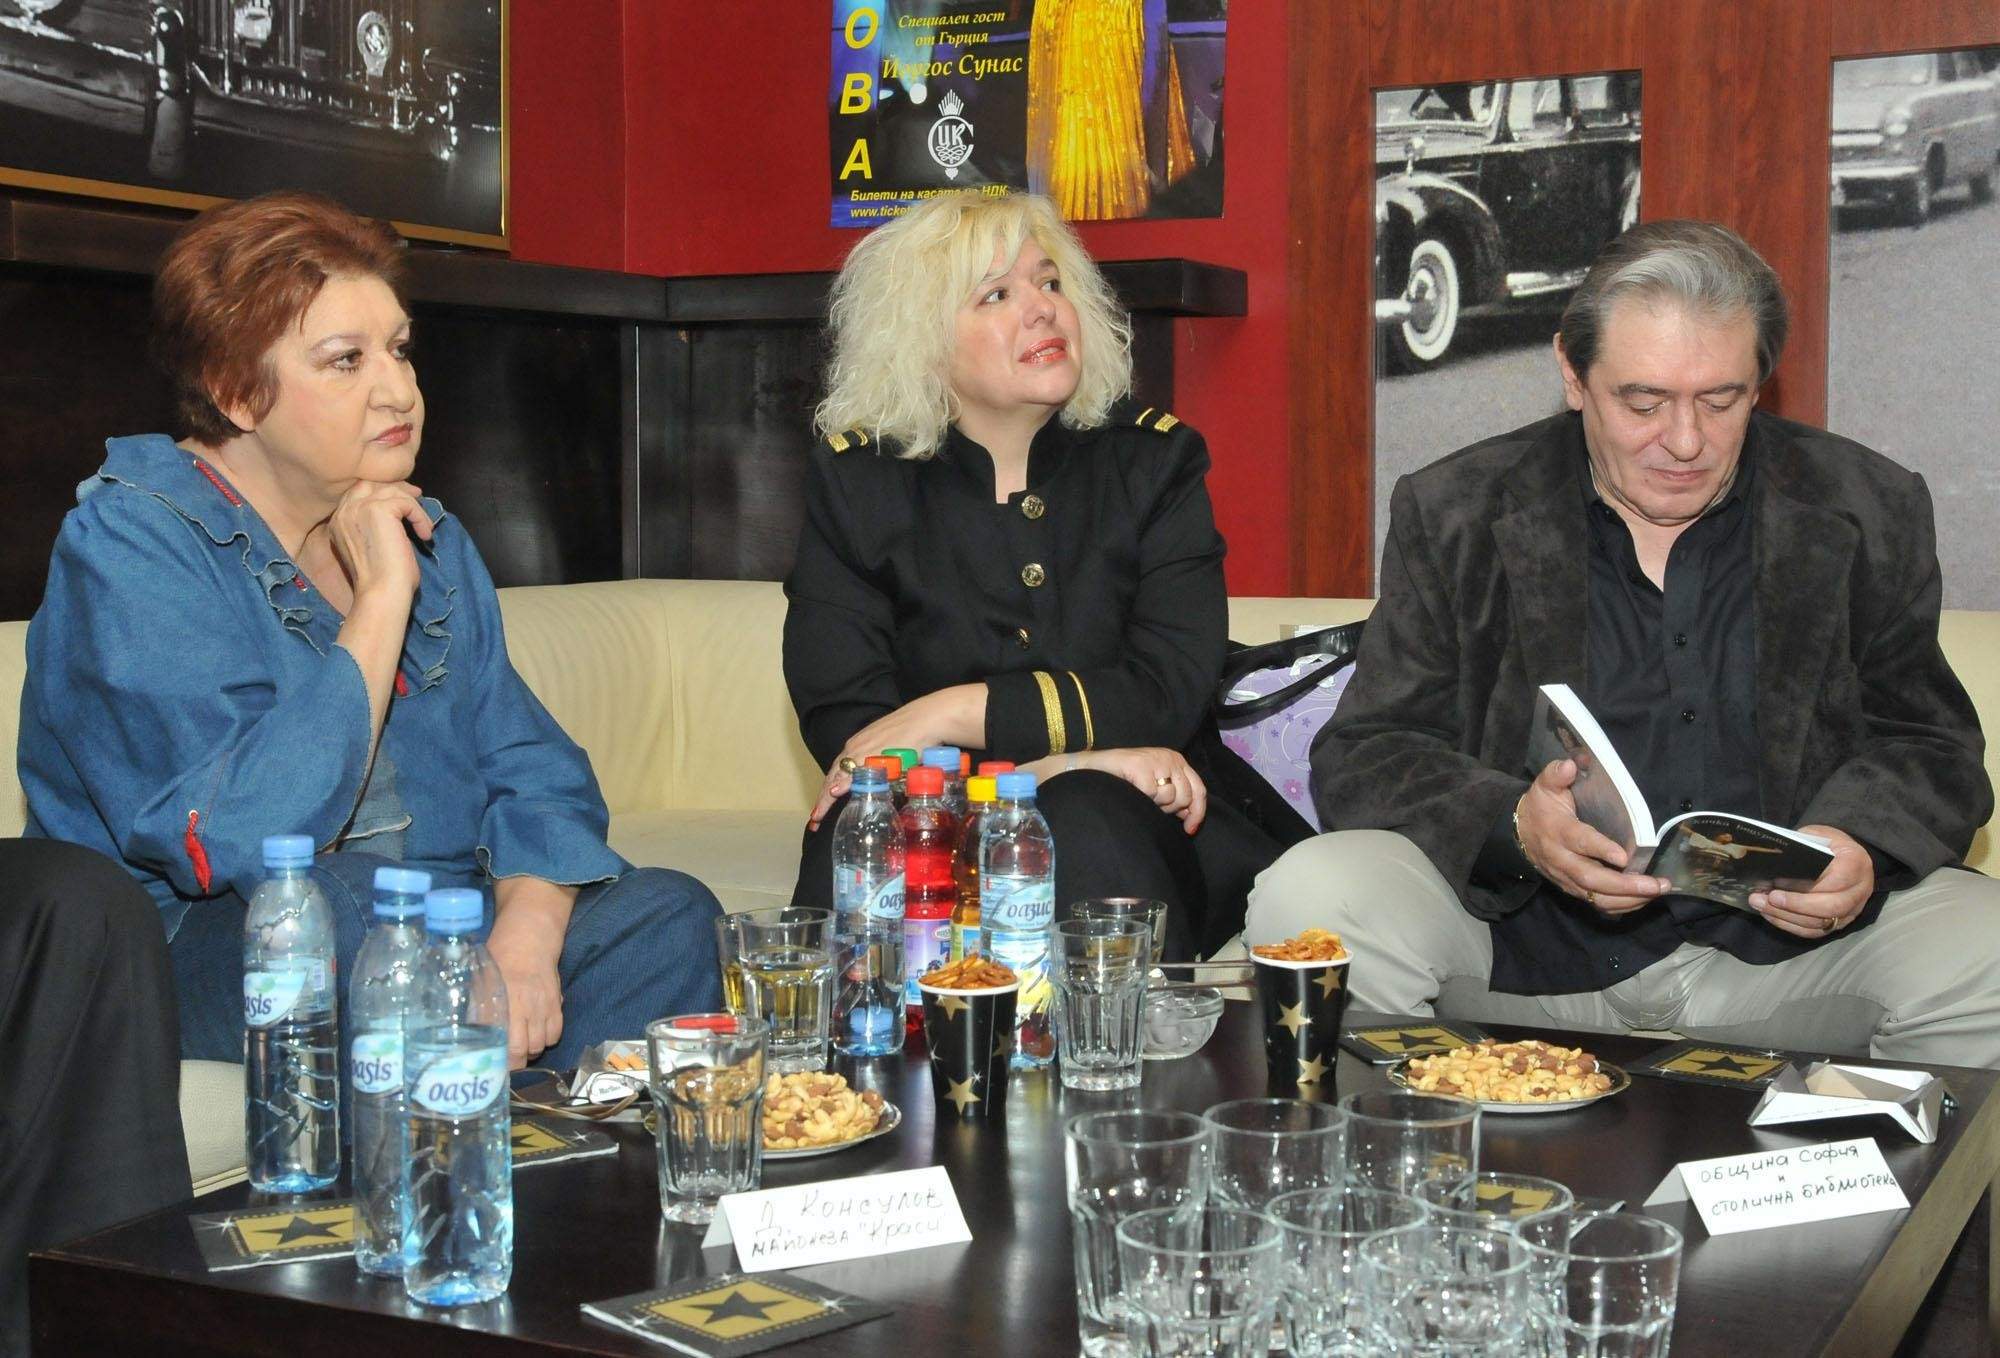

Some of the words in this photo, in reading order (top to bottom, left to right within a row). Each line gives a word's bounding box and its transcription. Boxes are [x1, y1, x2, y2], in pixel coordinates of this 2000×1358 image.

[898, 13, 969, 29] Специален
[973, 11, 1005, 24] гост
[915, 35, 935, 47] от
[939, 31, 988, 48] Гърция
[958, 54, 1023, 80] Сунас
[850, 189, 897, 201] Билети
[900, 190, 914, 200] на
[428, 1076, 490, 1106] oasis
